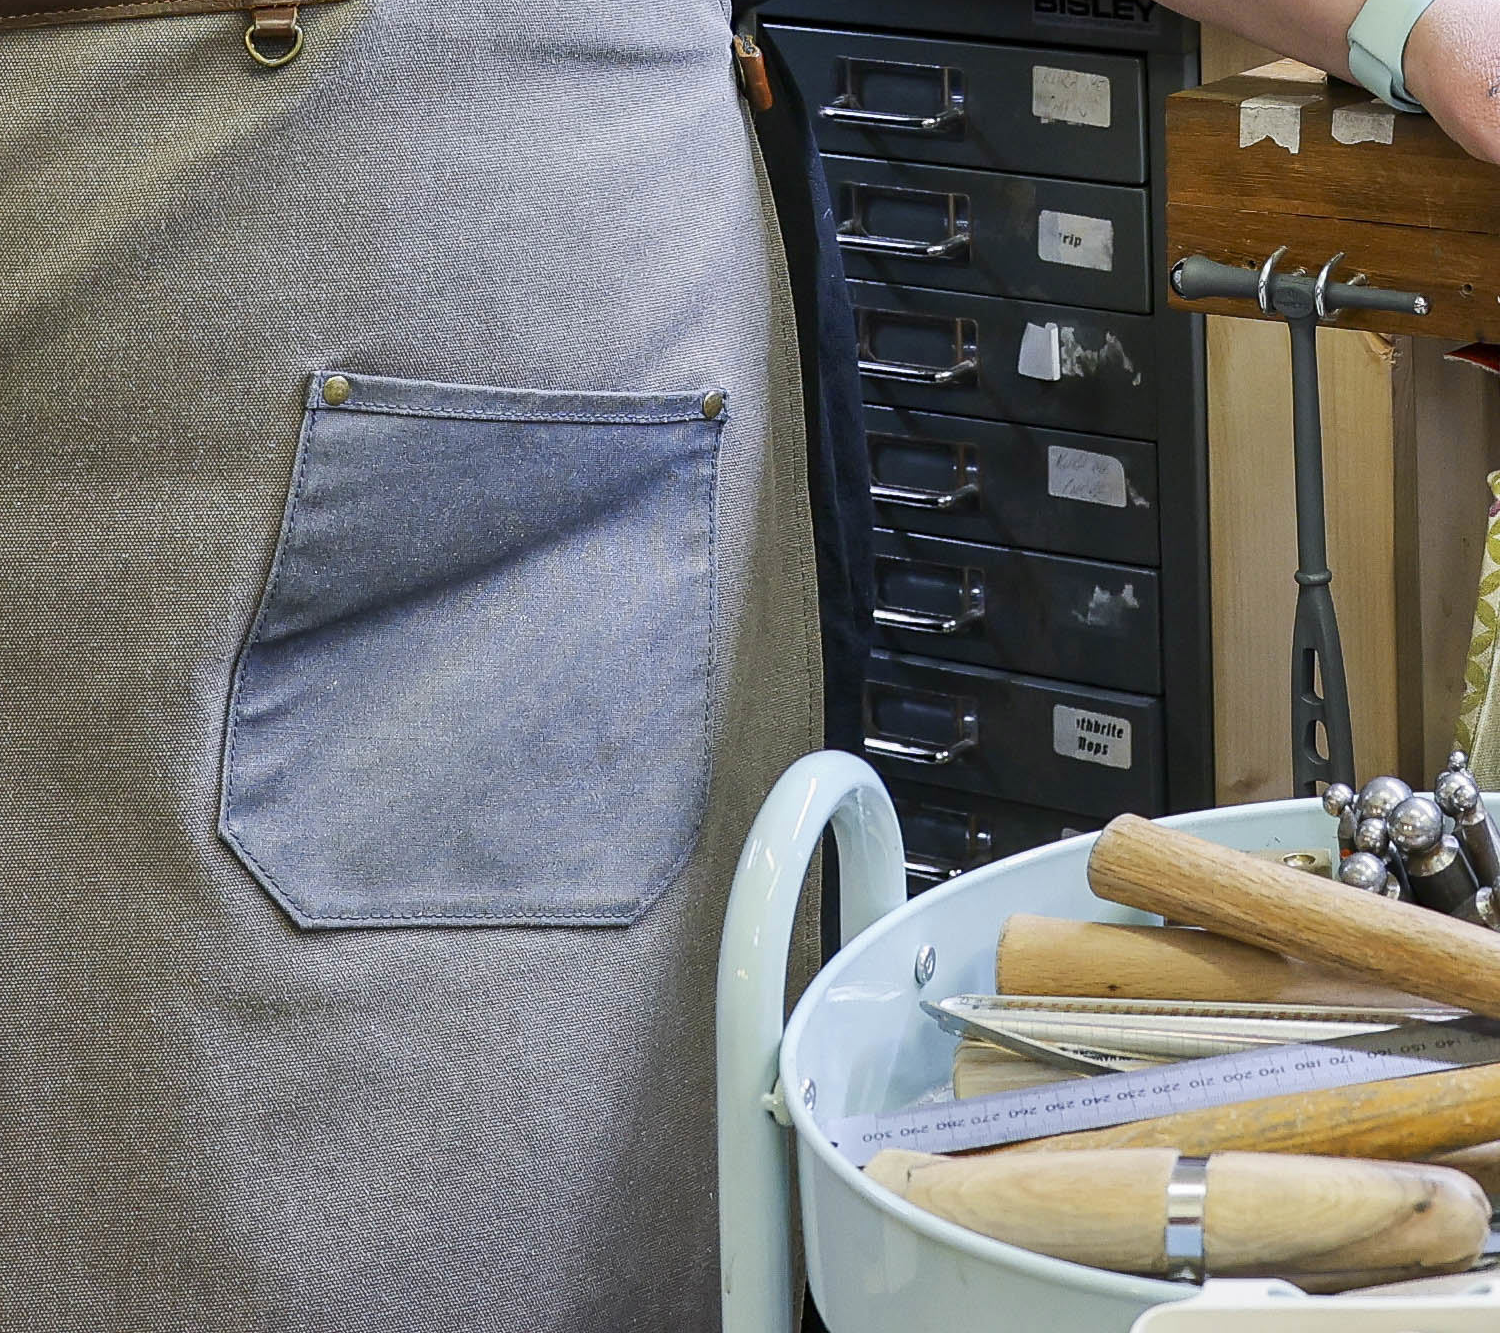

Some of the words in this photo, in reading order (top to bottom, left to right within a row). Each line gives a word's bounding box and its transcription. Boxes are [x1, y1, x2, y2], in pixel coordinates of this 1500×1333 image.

[1294, 1059, 1322, 1072] 180
[1329, 1054, 1355, 1067] 170
[1222, 1071, 1253, 1084] 200
[1258, 1066, 1286, 1078] 190
[1151, 1082, 1181, 1095] 220
[1188, 1077, 1215, 1090] 210
[1081, 1094, 1112, 1107] 240
[1116, 1088, 1147, 1101] 230
[1045, 1100, 1075, 1113] 250
[970, 1113, 1000, 1126] 270
[1007, 1107, 1037, 1120] 260
[899, 1124, 929, 1137] 290
[935, 1119, 966, 1132] 280
[861, 1130, 894, 1143] 300
